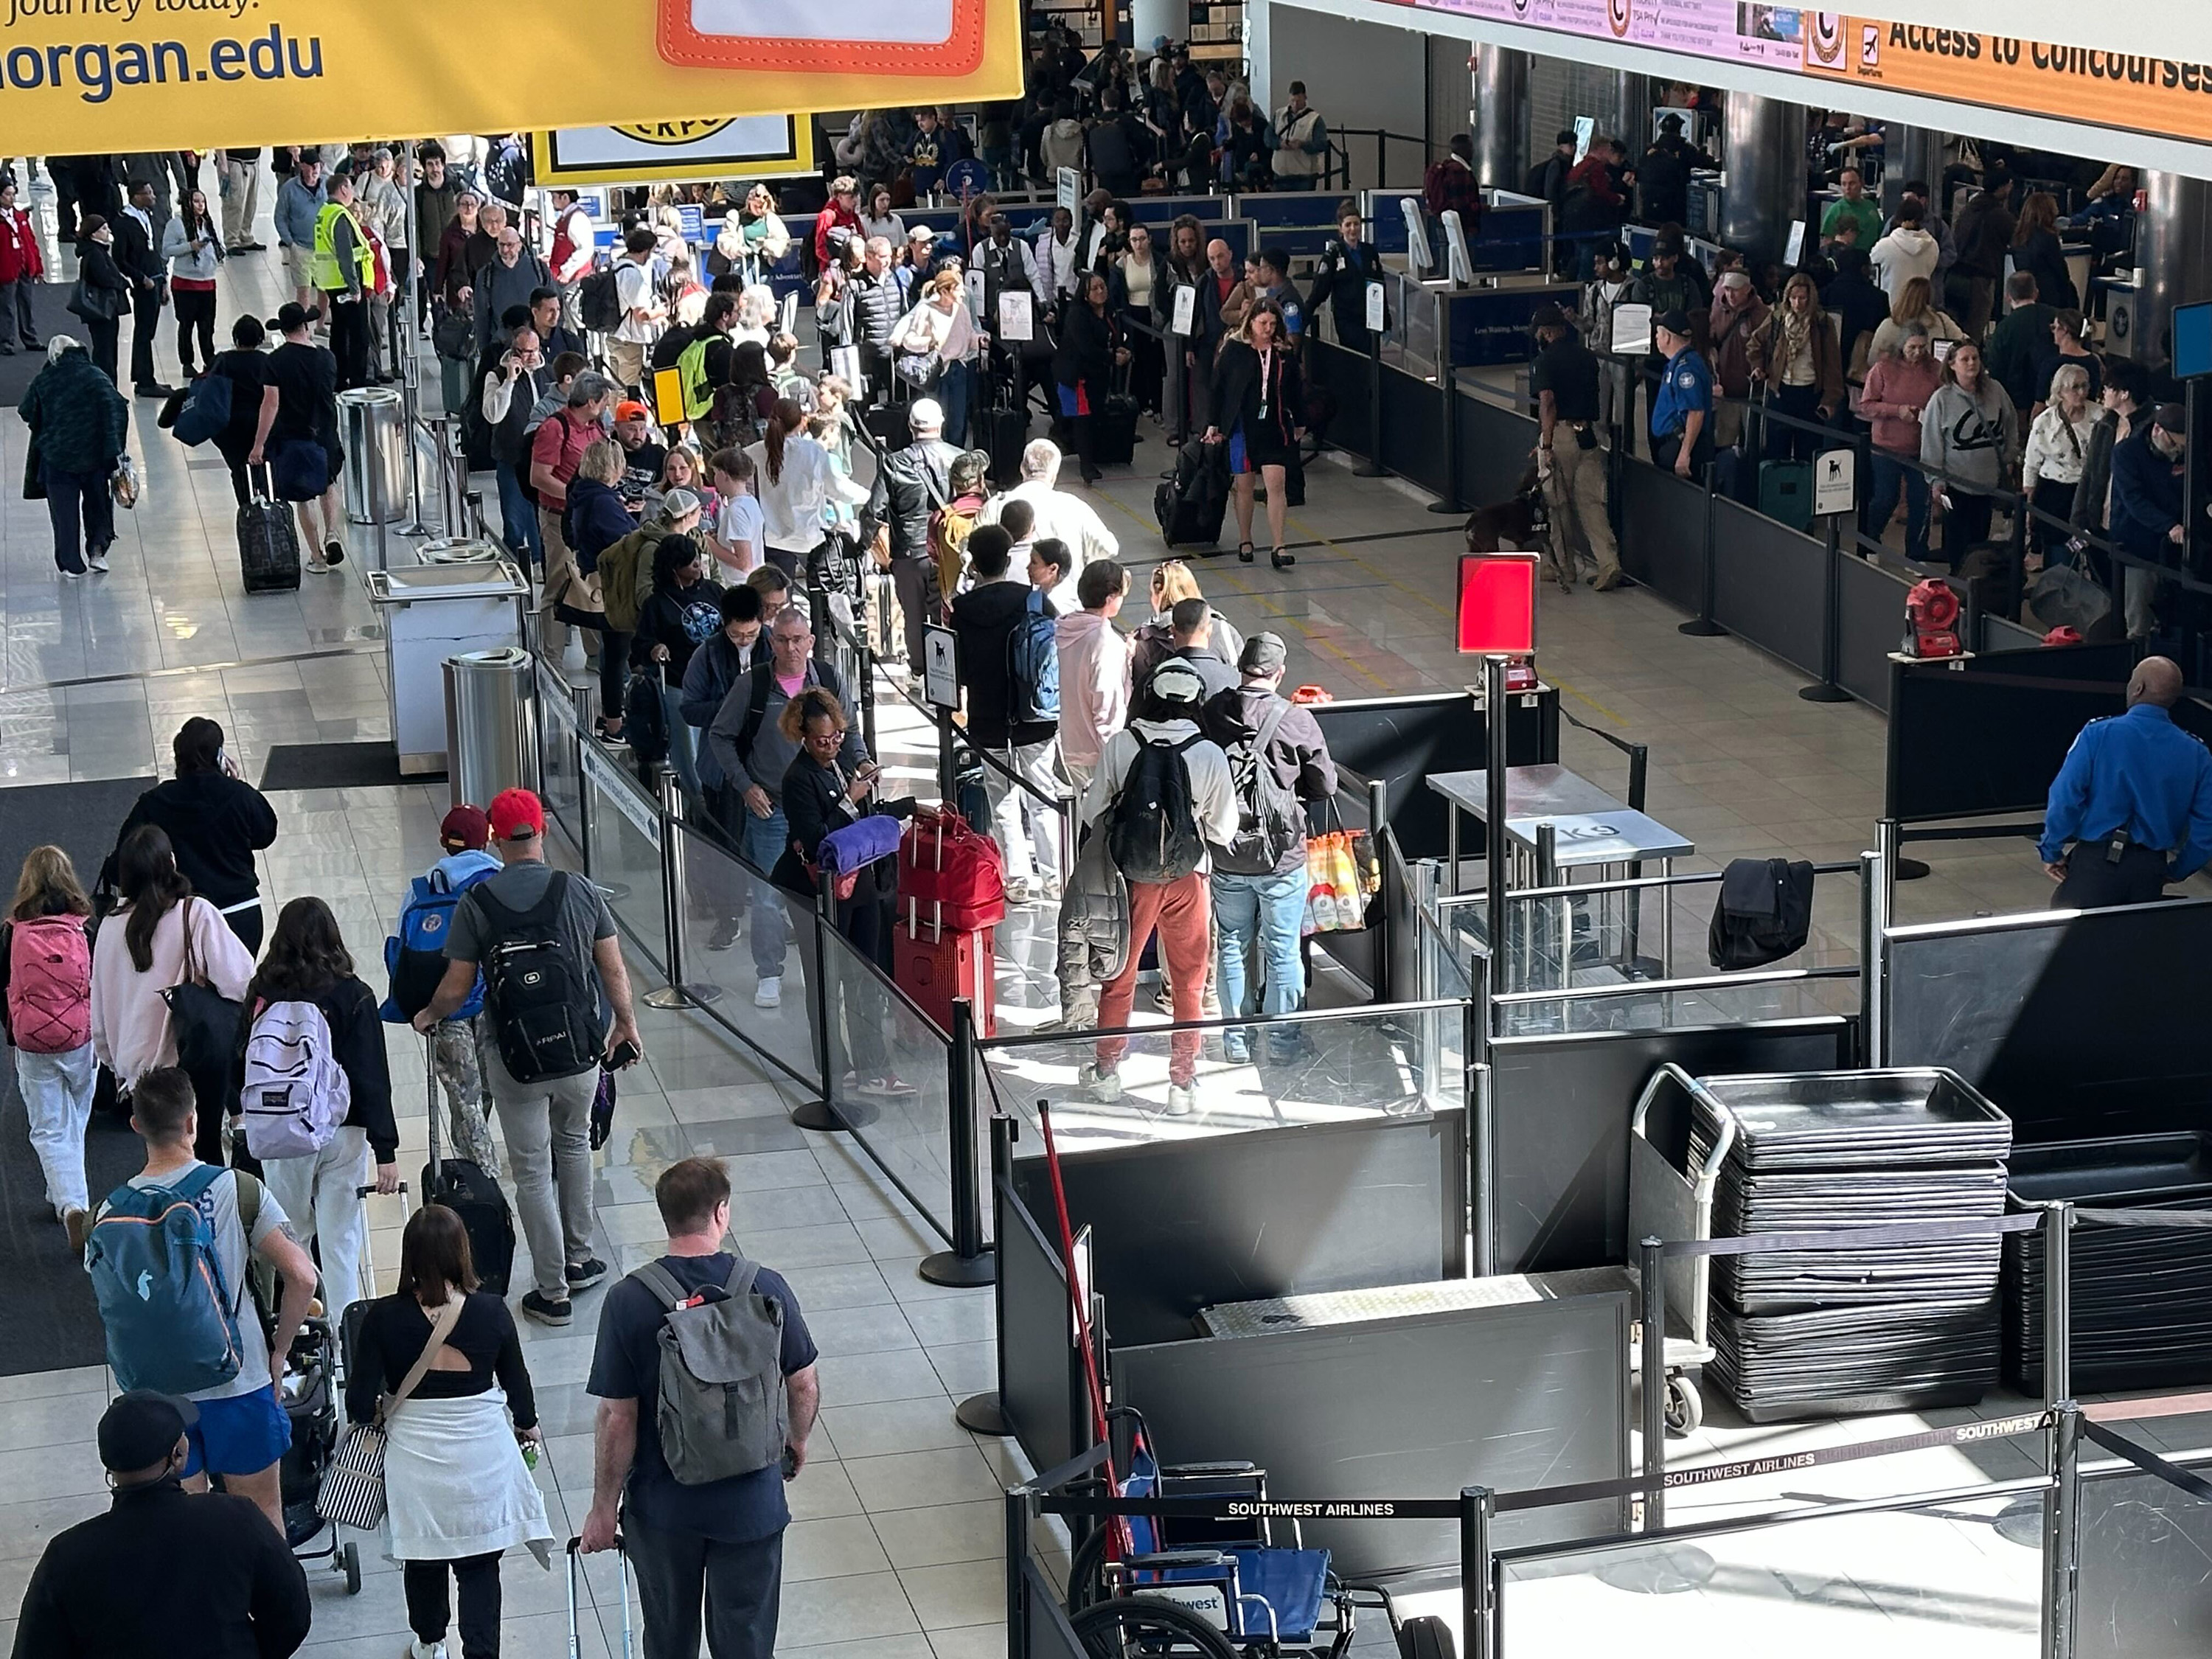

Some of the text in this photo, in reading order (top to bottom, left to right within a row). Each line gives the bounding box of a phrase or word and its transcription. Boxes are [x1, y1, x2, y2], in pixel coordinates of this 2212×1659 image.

[1889, 22, 1981, 59] Access
[1992, 37, 2020, 65] to
[0, 23, 324, 103] organ.edu
[1559, 825, 1621, 839] K9
[1956, 1416, 2041, 1441] SOUTHWEST
[1663, 1453, 1815, 1486] SOUTHWEST AIRLINES
[1228, 1503, 1394, 1516] SOUTHWEST AIRLINES
